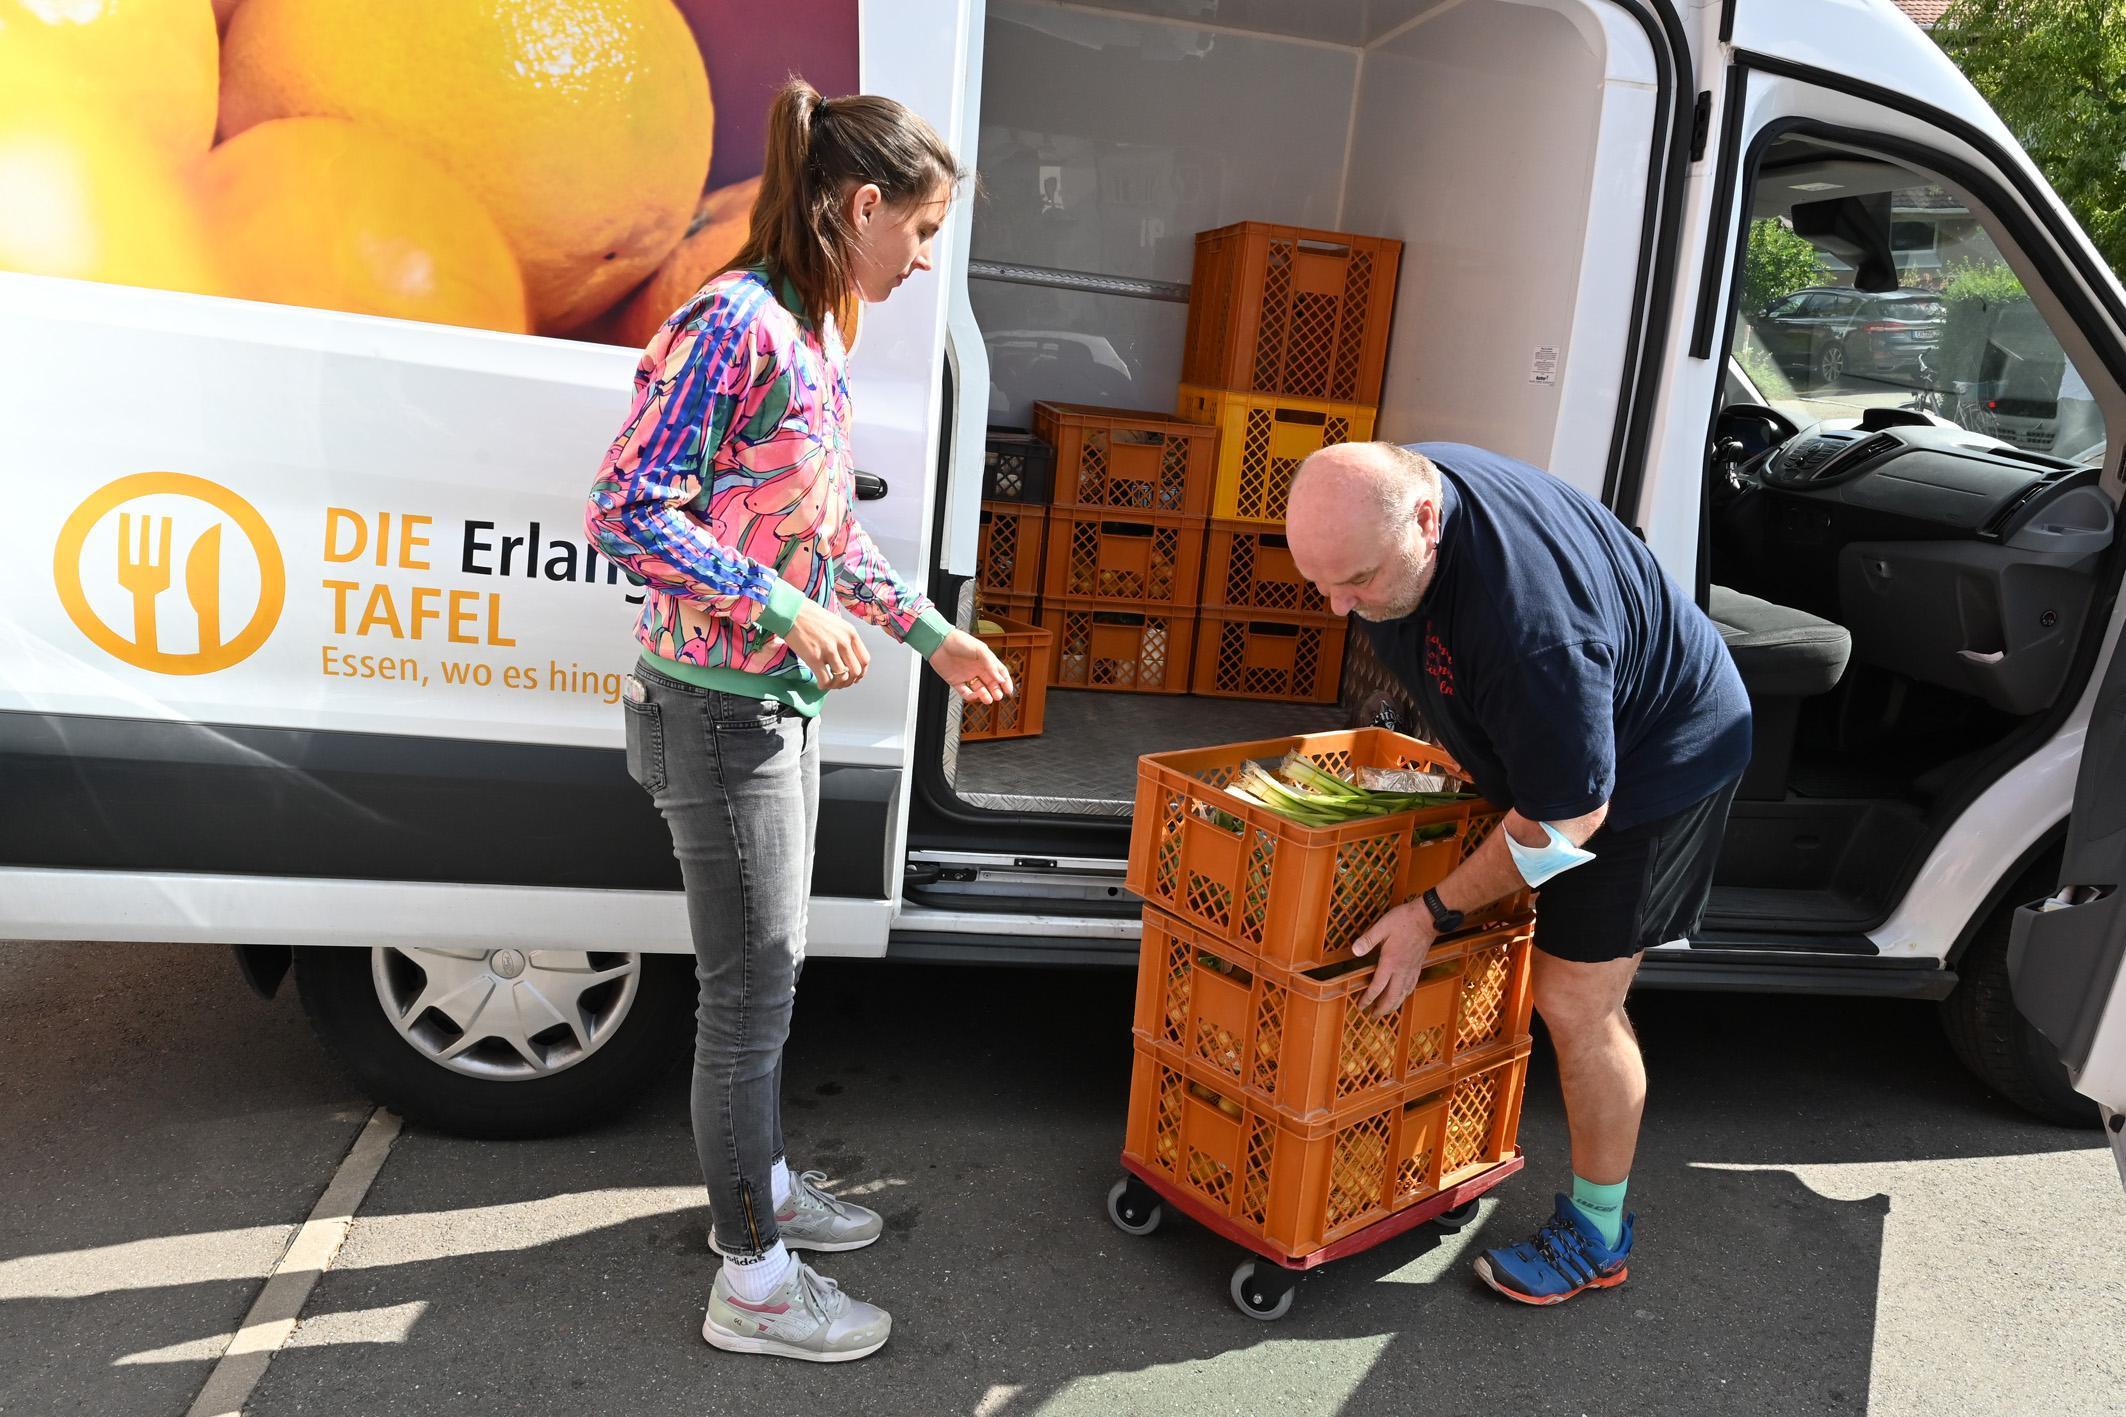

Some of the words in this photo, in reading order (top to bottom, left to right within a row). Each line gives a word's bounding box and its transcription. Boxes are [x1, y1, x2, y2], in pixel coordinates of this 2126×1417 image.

[323, 506, 433, 571] DIE
[322, 579, 517, 648] TAFEL
[322, 645, 429, 690] Essen,
[441, 661, 493, 687] wo
[503, 665, 539, 690] es
[549, 659, 622, 705] hing
